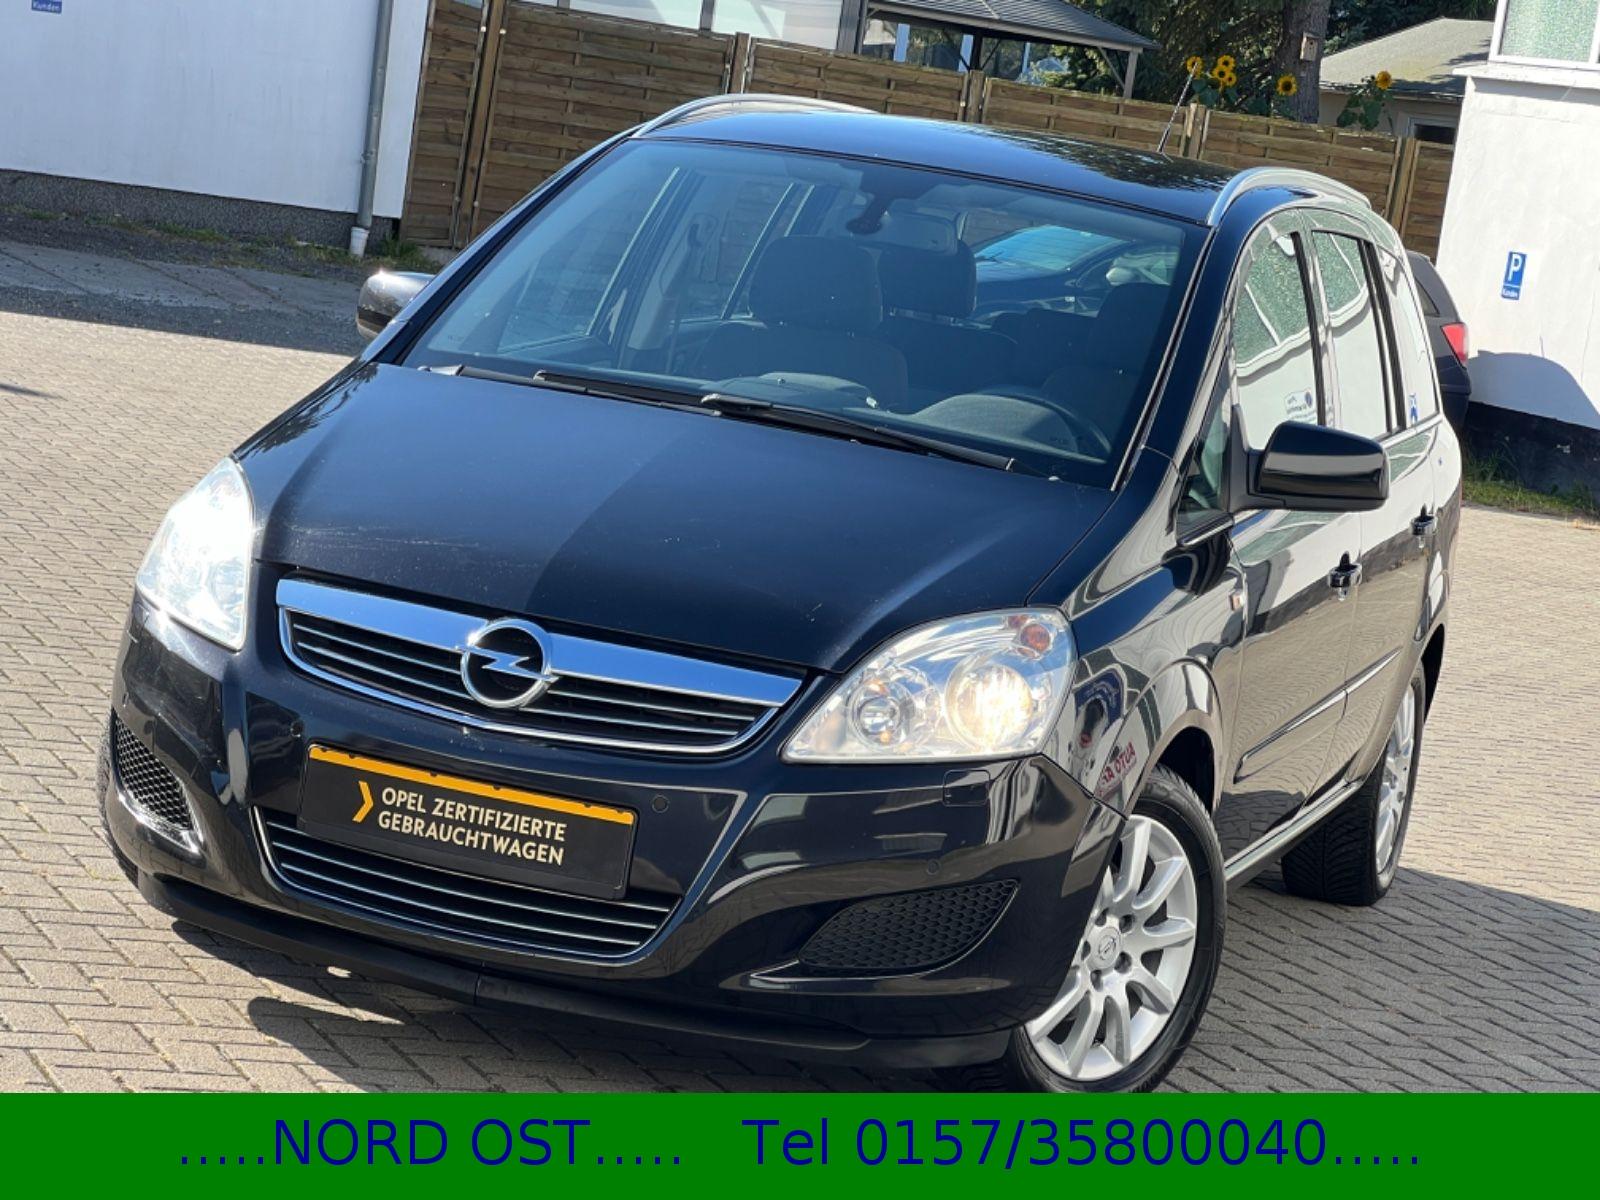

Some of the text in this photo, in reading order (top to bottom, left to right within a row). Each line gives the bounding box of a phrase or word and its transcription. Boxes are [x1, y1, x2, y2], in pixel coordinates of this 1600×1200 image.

[1508, 253, 1523, 281] P
[378, 811, 565, 866] GEBRAUCHTWAGEN
[381, 786, 567, 842] OPEL ZERTIFIZIERTE
